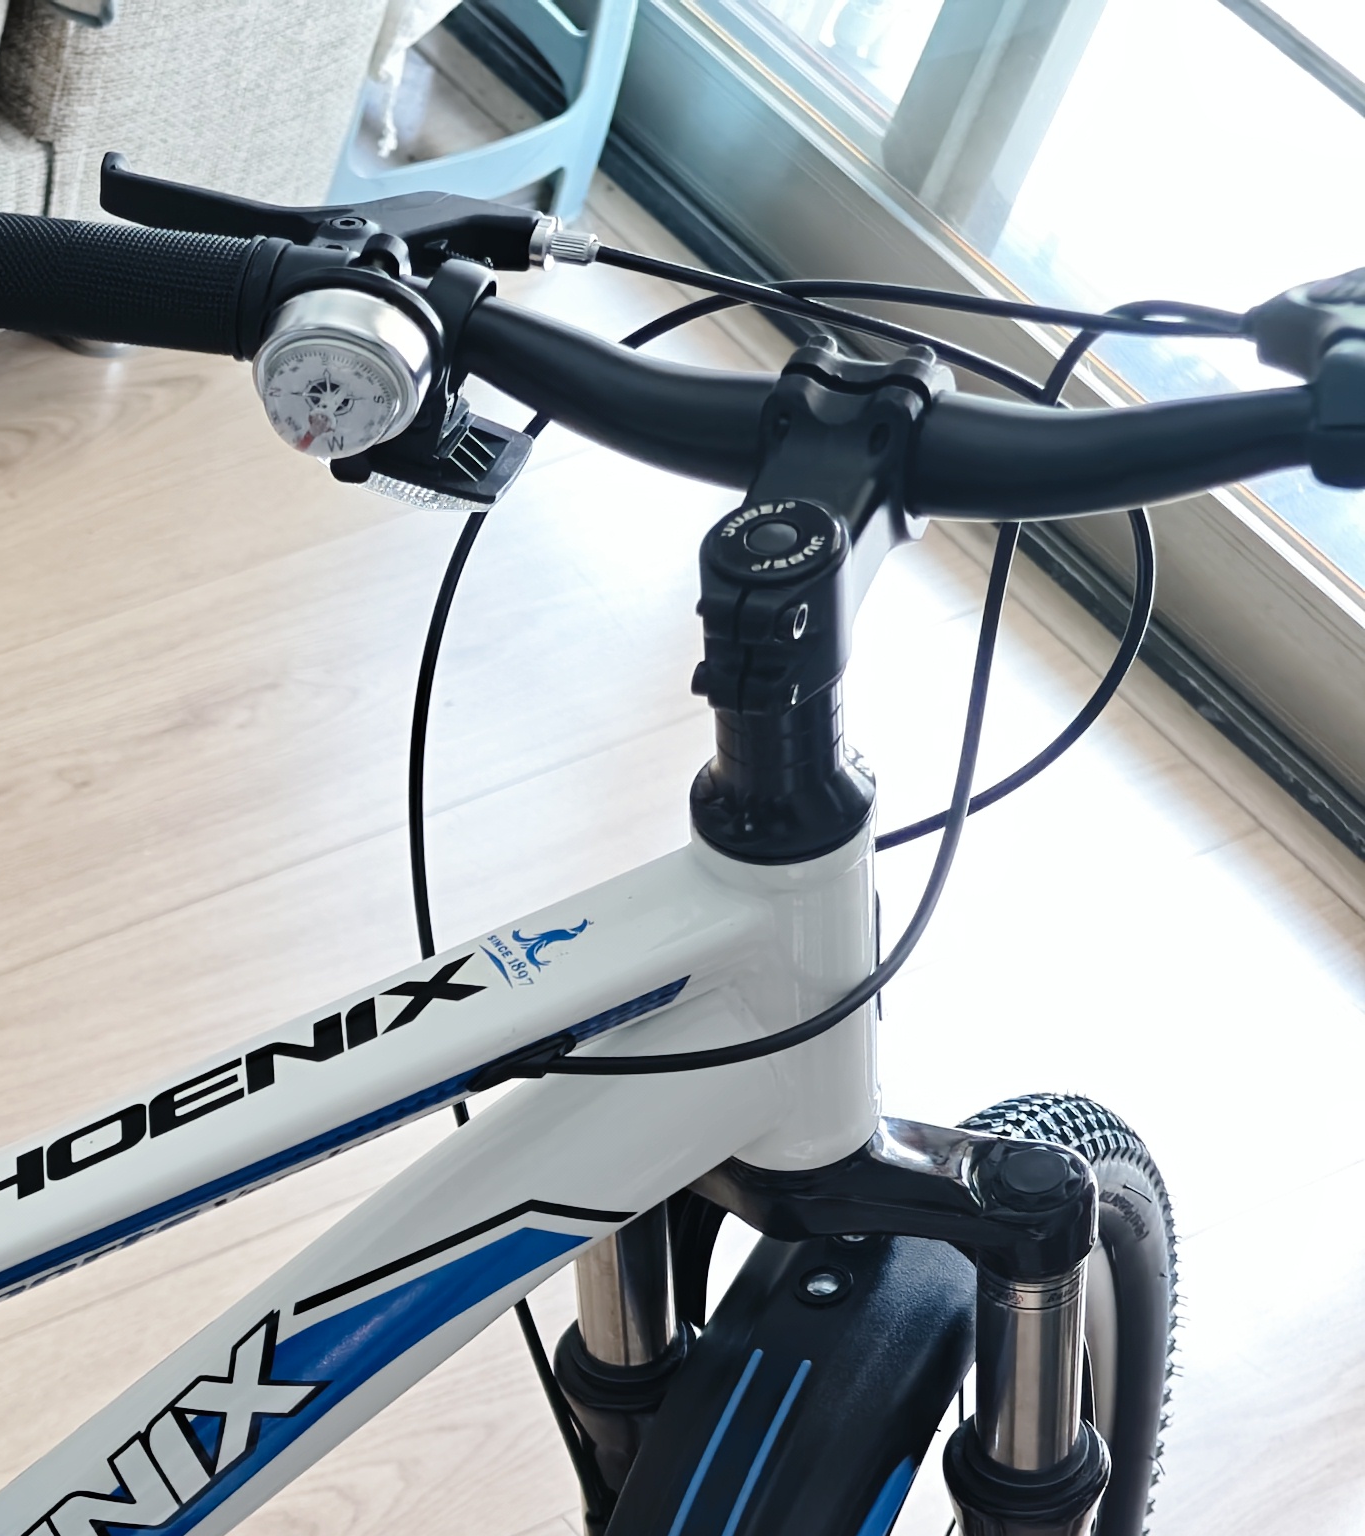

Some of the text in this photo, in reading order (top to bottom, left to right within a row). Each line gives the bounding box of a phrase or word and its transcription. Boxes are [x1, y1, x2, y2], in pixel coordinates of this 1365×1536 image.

[327, 435, 345, 453] W
[487, 934, 535, 986] SINCE 1897
